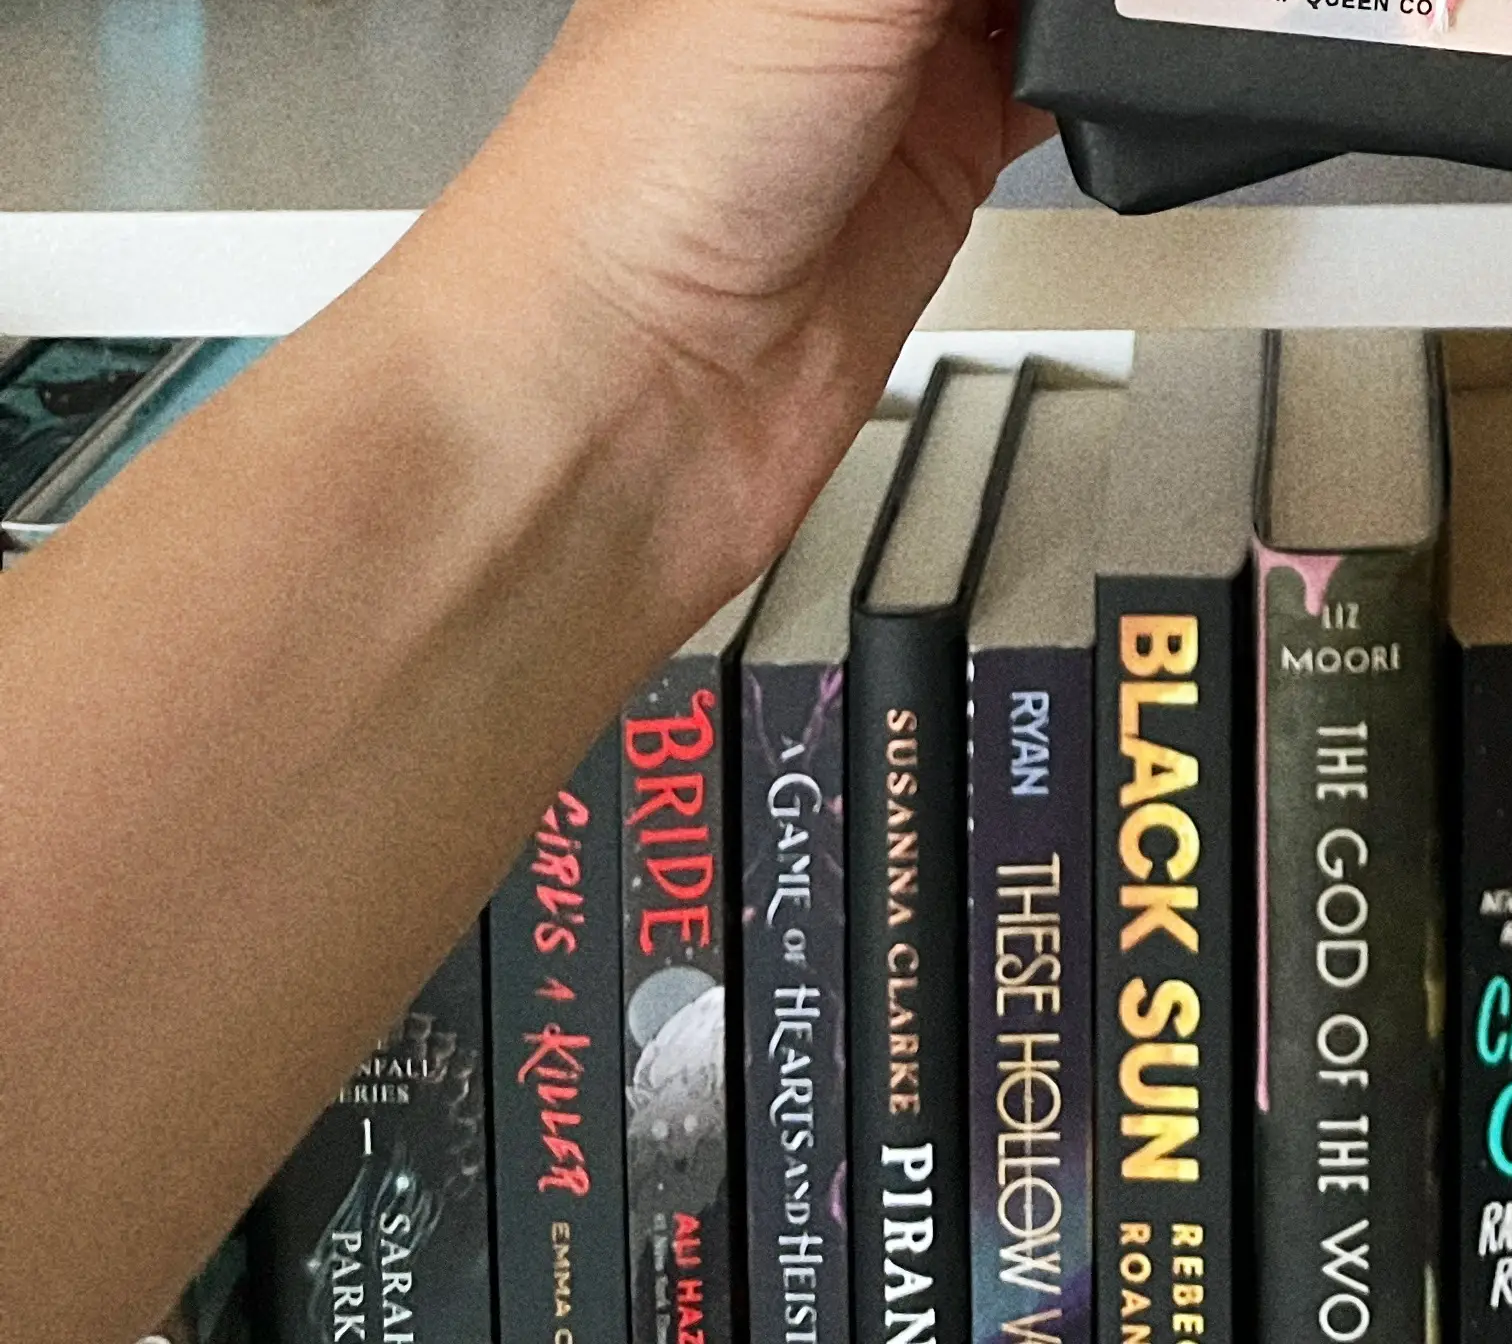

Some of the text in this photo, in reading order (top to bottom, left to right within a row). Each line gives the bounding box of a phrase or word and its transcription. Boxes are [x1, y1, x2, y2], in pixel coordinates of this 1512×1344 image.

[624, 688, 718, 956] BRIDE
[1010, 690, 1051, 797] RYAN
[887, 942, 921, 1116] CLARKE
[1119, 614, 1201, 1184] BLACK SUN
[1316, 720, 1371, 1195] THE GOD OF THE
[995, 852, 1063, 1297] THESE HOLLOW
[551, 1220, 573, 1319] EMMA
